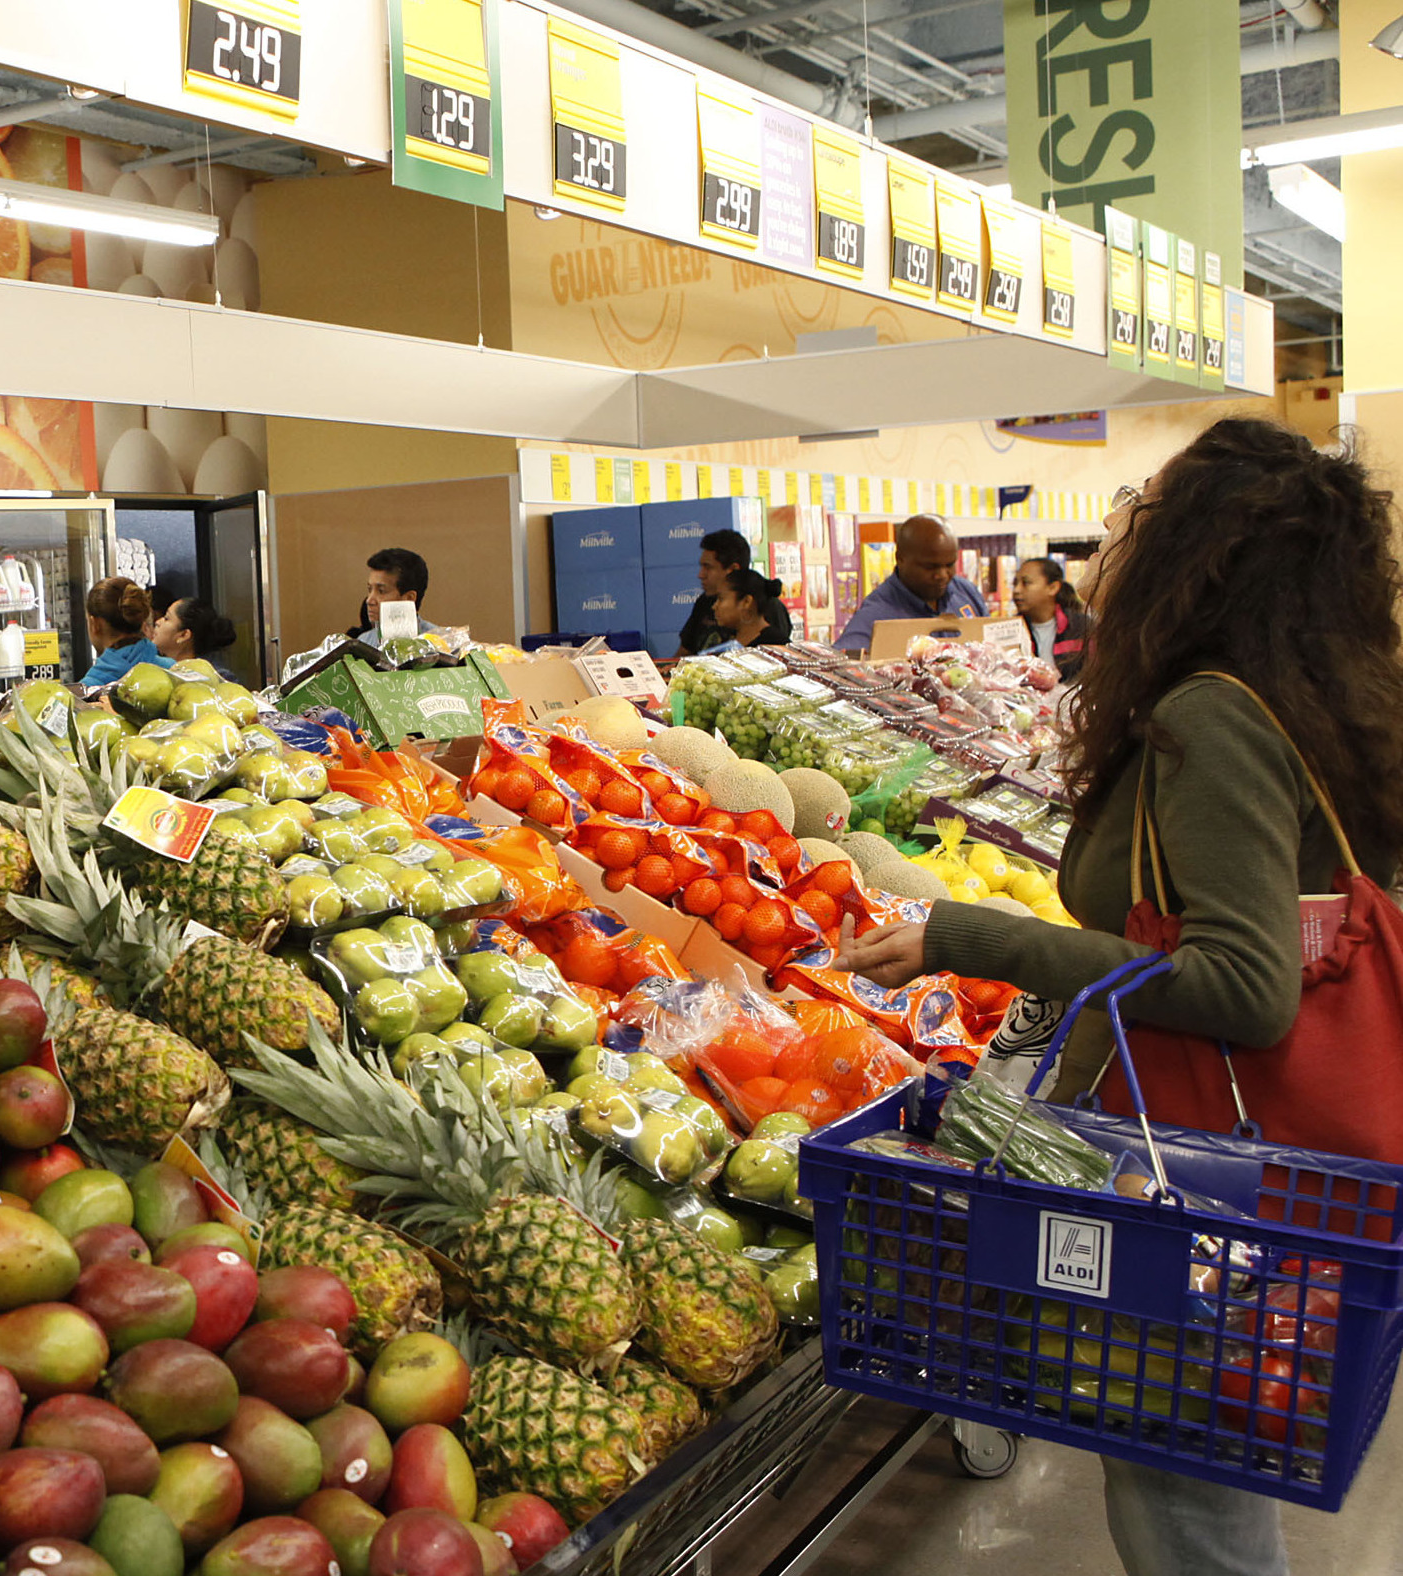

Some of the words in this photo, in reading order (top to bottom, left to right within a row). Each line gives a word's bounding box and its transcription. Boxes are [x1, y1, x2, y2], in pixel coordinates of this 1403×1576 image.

[212, 10, 282, 93] 2.49
[553, 57, 587, 83] Oranges
[431, 88, 474, 150] 1.29
[1035, 0, 1155, 242] RESH
[572, 132, 614, 191] 3.29
[716, 178, 752, 232] 2.99
[834, 220, 858, 264] 1.89
[906, 244, 928, 285] 1.59
[948, 257, 973, 299] 2.49
[580, 537, 615, 548] Millville
[669, 528, 705, 539] Millville
[582, 600, 617, 611] Millville
[1054, 1262, 1094, 1282] ALDI
